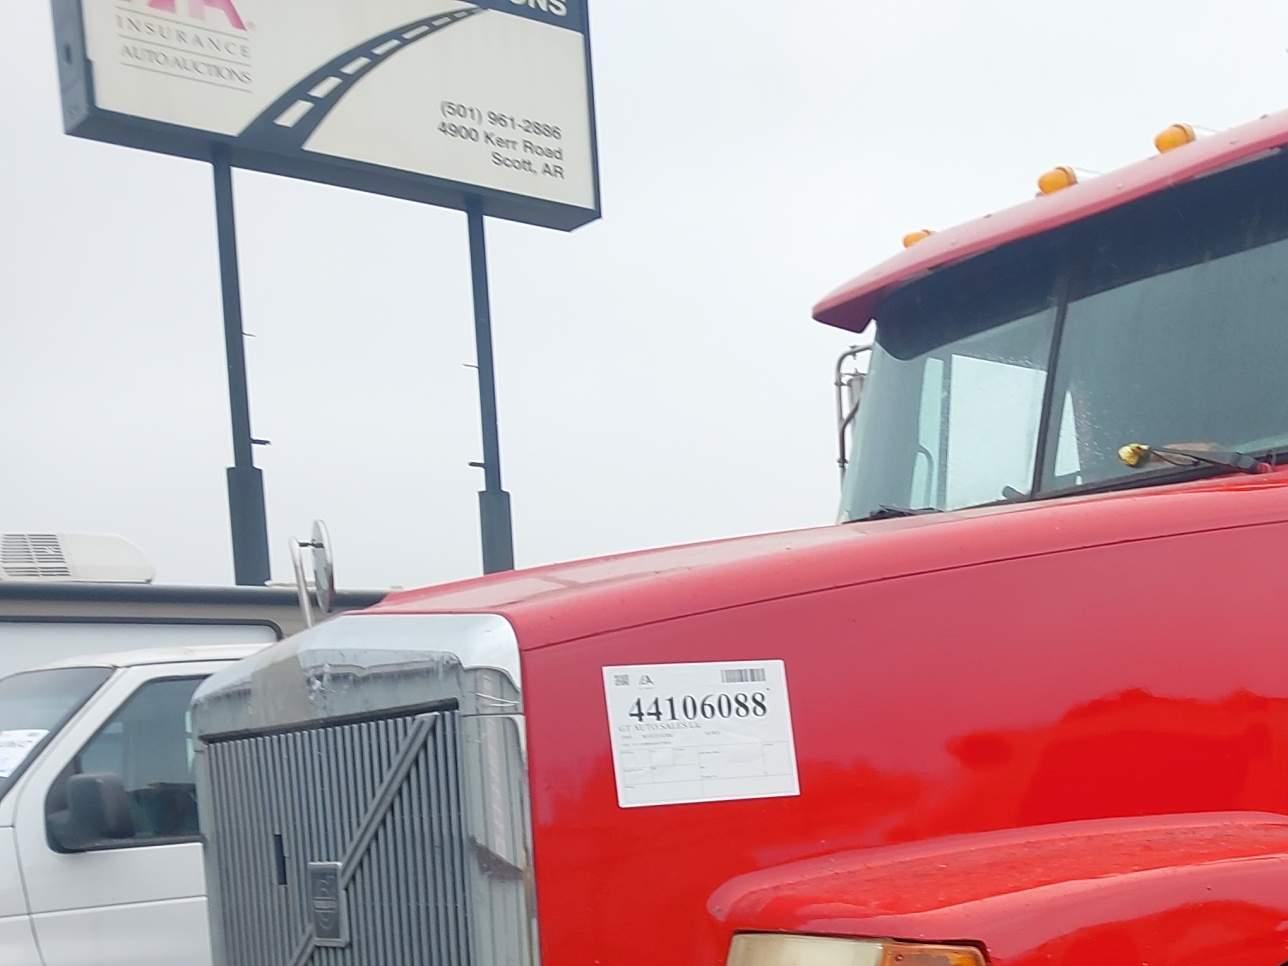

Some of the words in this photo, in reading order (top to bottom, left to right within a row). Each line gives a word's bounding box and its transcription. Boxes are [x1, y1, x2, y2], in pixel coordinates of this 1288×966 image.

[115, 14, 250, 58] INSURANCE
[440, 100, 482, 125] (501)
[437, 121, 479, 142] 4900
[483, 130, 518, 151] Kerr
[521, 139, 563, 161] Road
[491, 151, 538, 176] Scott,
[542, 162, 565, 179] AR
[629, 692, 768, 722] 44106088
